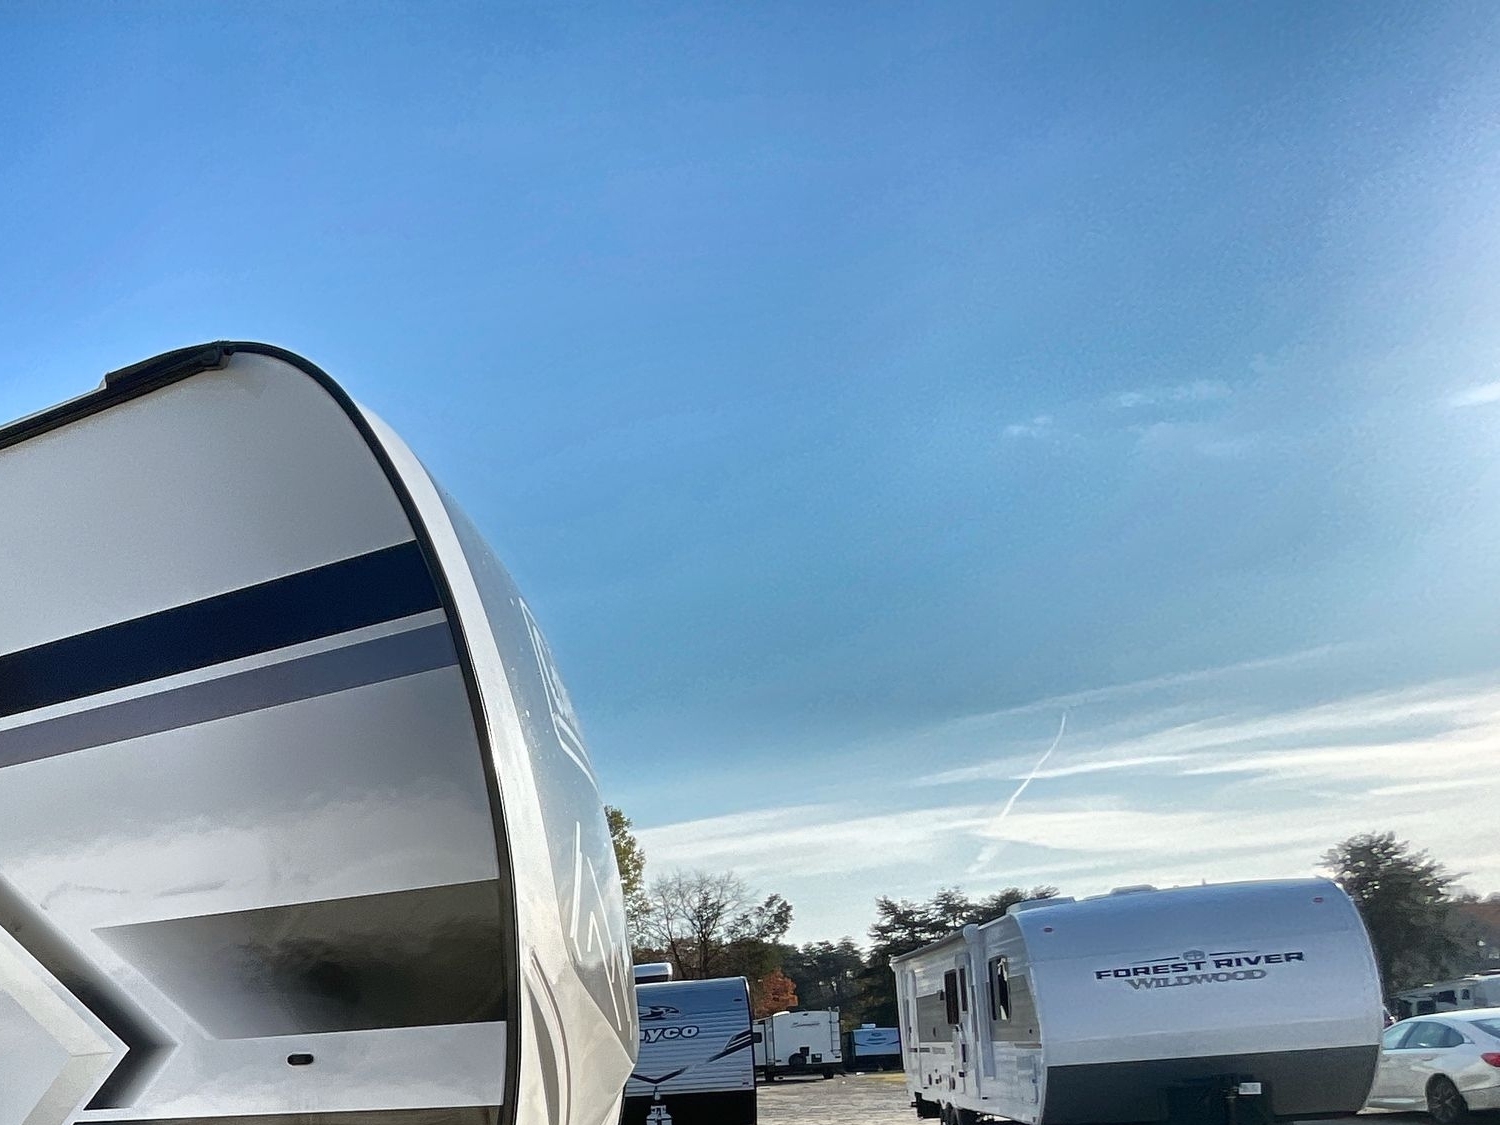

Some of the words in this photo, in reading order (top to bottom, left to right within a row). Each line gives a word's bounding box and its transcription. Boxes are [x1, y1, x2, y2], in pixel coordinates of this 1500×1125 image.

[1095, 961, 1206, 980] FOREST
[1213, 951, 1305, 969] RIVER
[1124, 969, 1267, 990] WILDWOOD
[639, 1025, 700, 1043] yco
